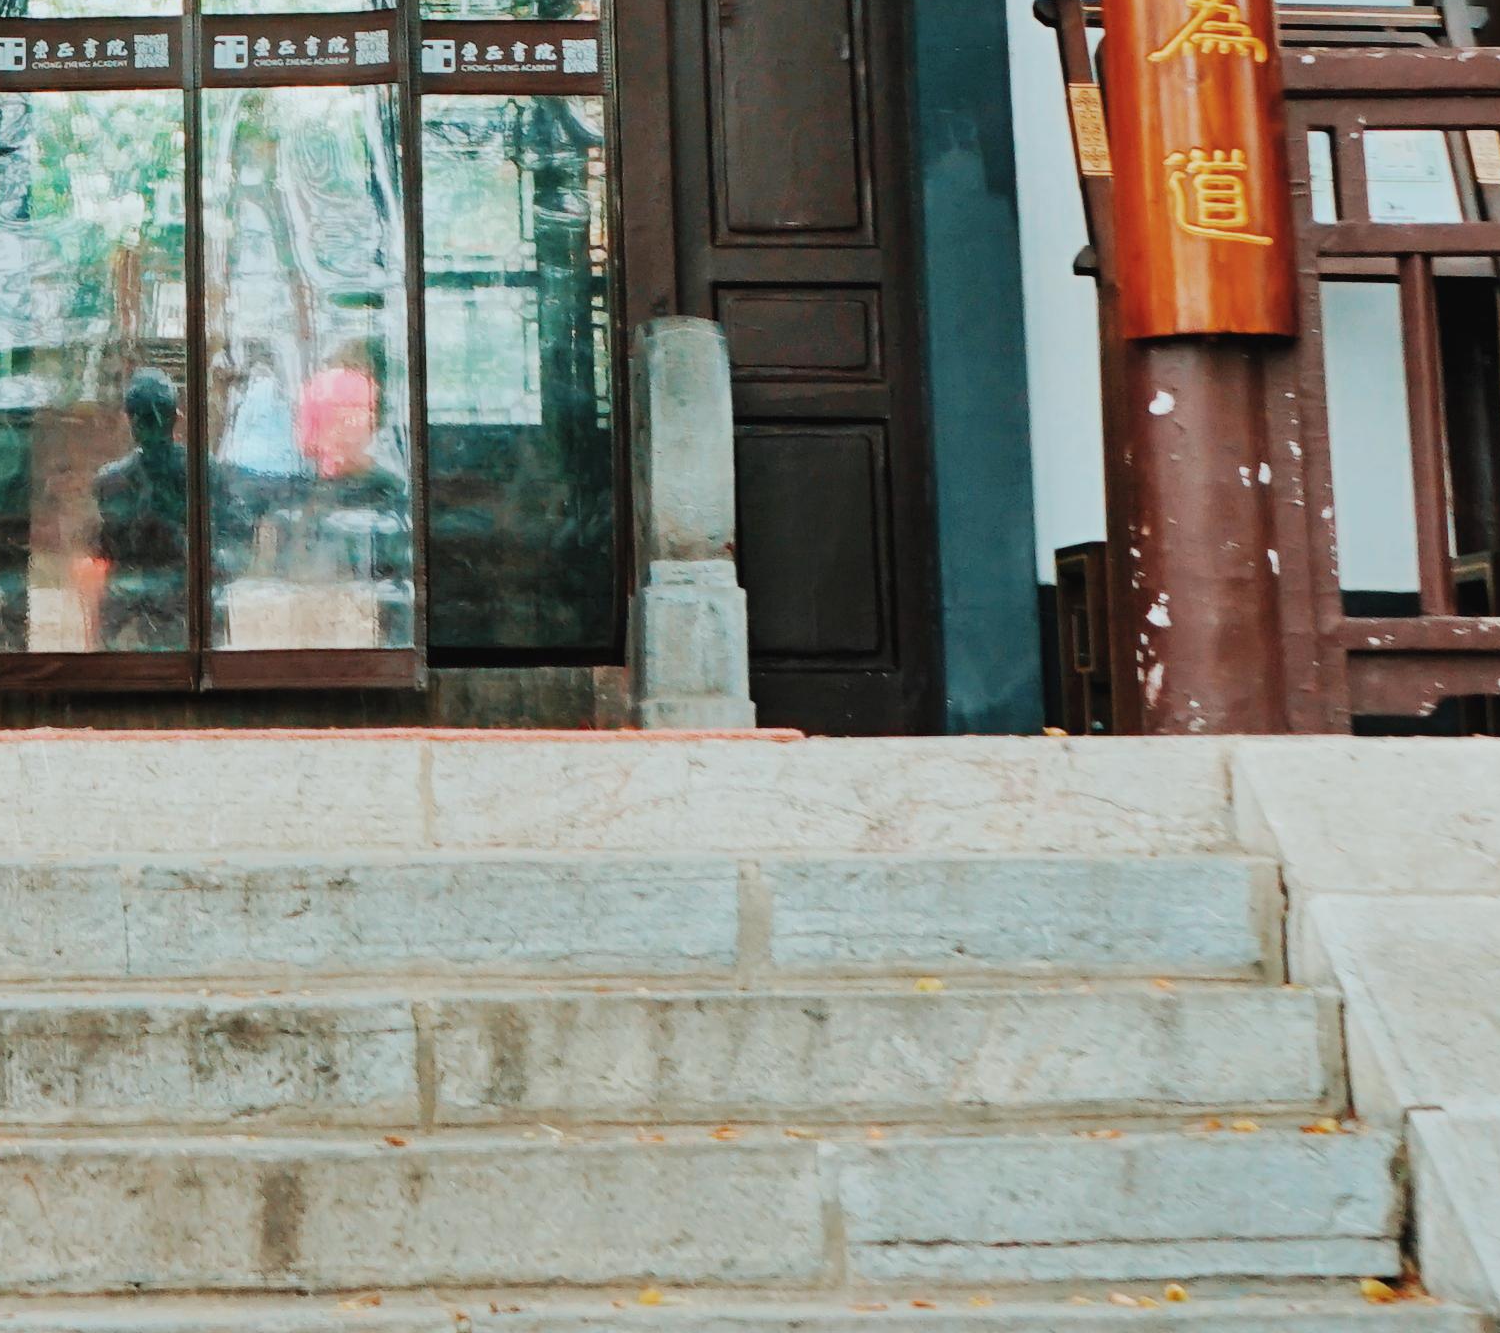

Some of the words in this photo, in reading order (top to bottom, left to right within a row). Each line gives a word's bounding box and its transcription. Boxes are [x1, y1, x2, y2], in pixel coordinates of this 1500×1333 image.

[31, 60, 62, 70] CHONG
[63, 60, 91, 69] ZHENG
[92, 59, 129, 68] ACADEMY
[253, 58, 285, 67] CHONG
[285, 58, 313, 66] ZHENG
[313, 56, 350, 65] ACADEMY
[460, 64, 492, 73] CHONG
[493, 64, 520, 72] ZHENG
[521, 63, 558, 72] ACADEMY
